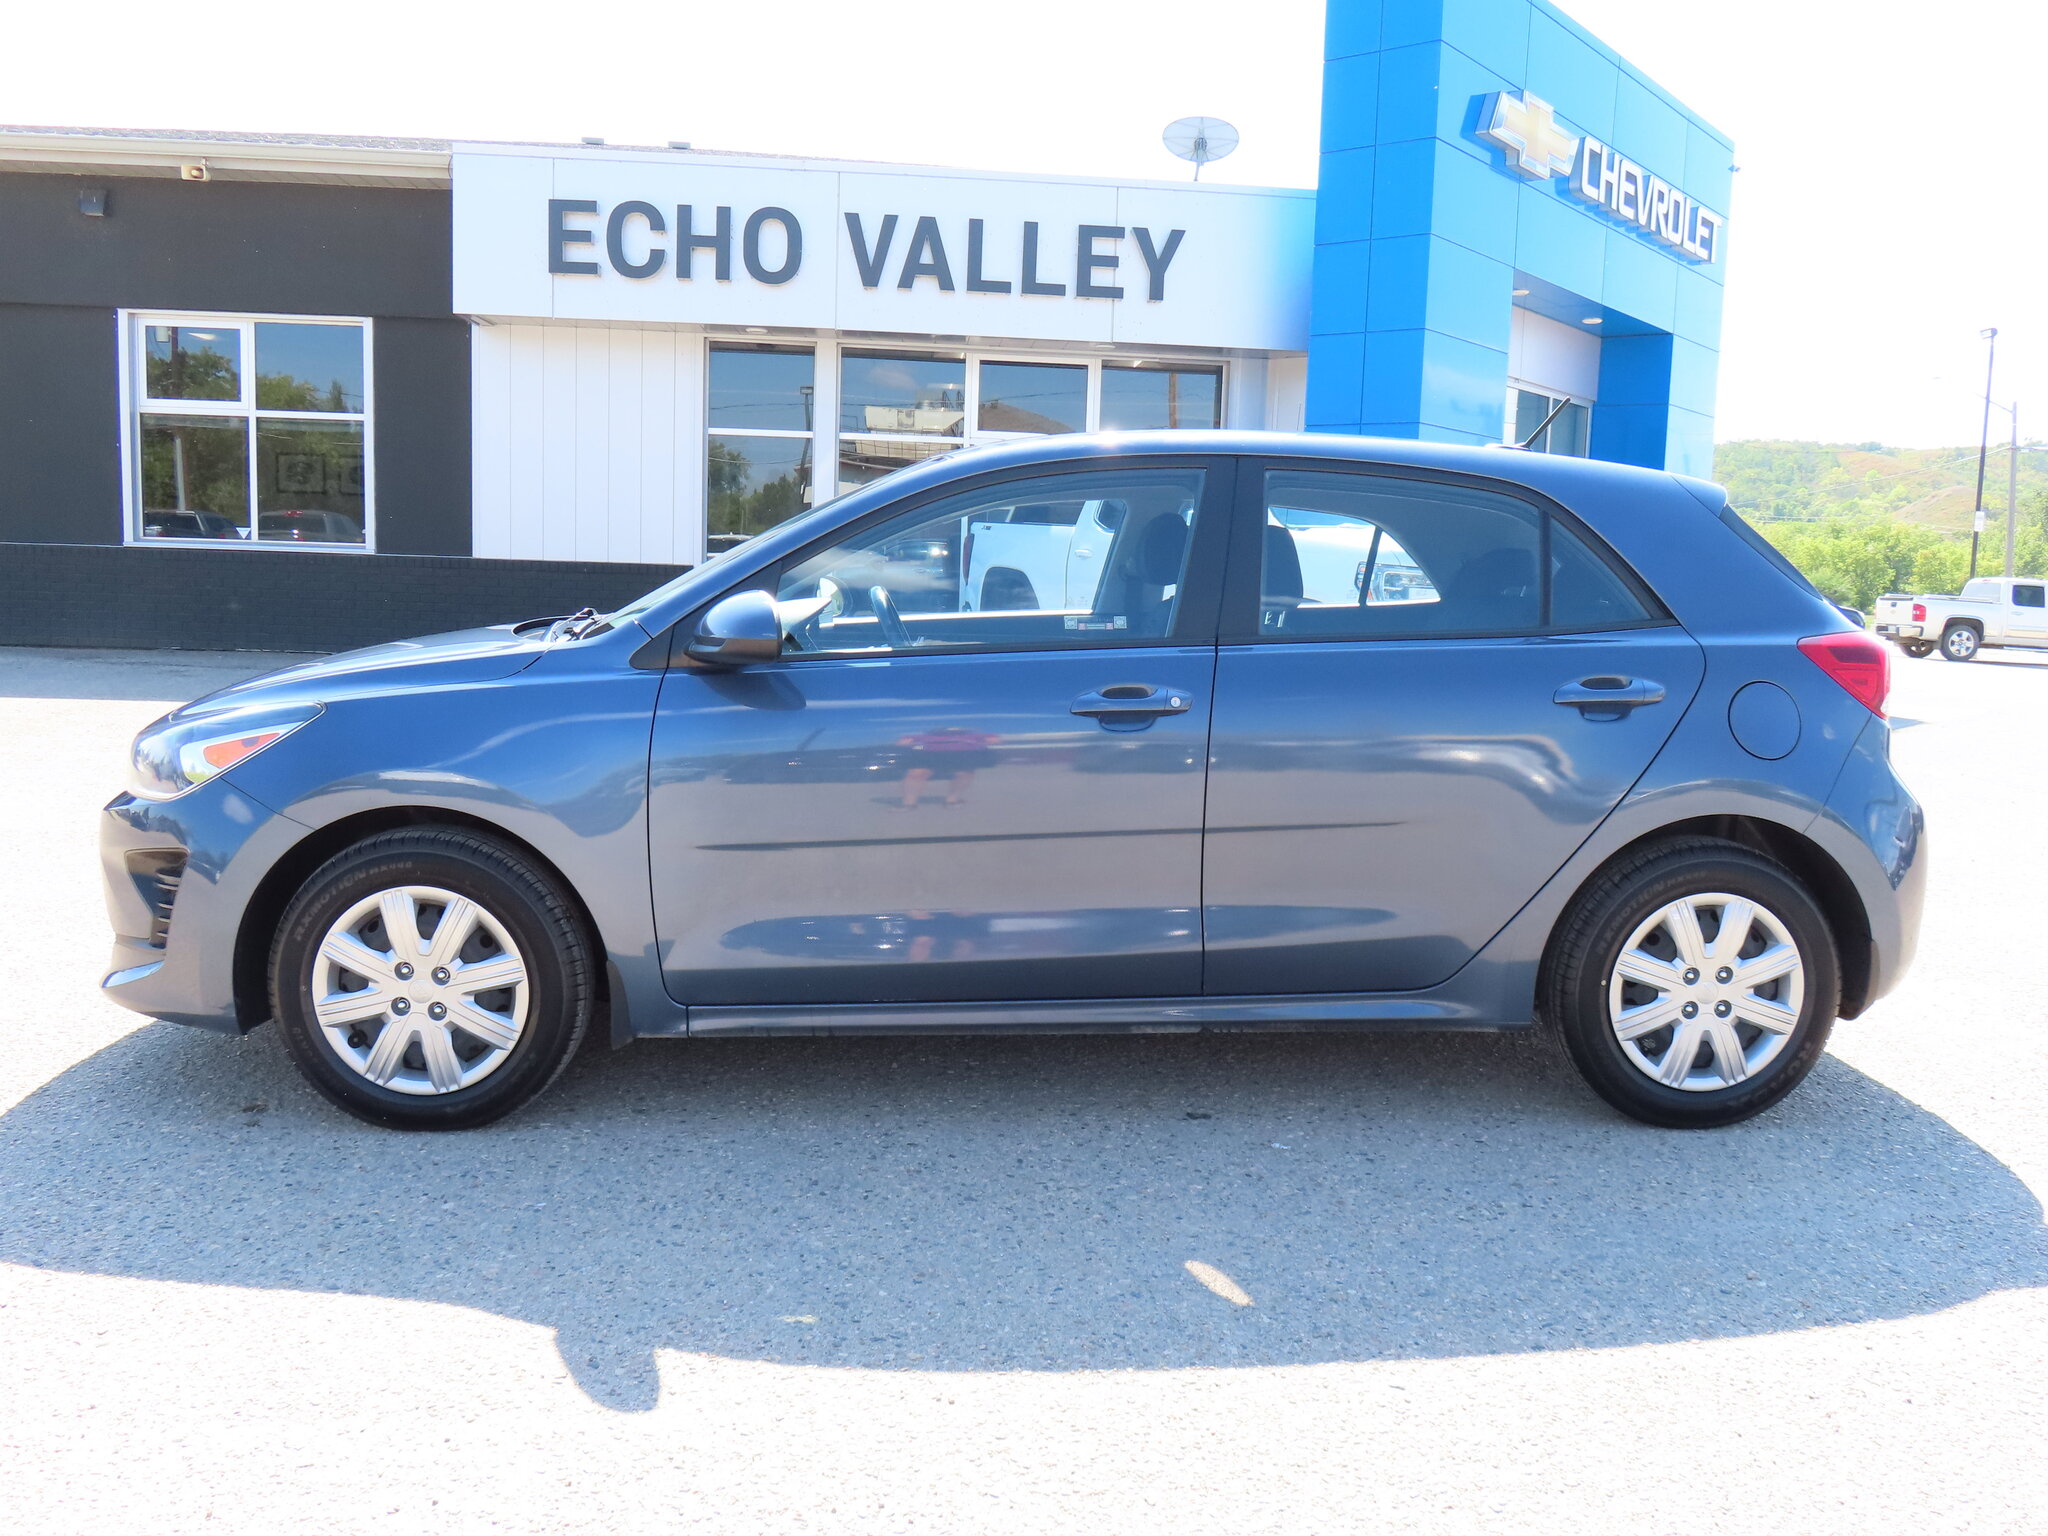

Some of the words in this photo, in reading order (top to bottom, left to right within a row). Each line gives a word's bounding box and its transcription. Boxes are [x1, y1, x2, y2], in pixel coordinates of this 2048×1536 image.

[548, 198, 802, 286] ECHO
[844, 211, 1187, 303] VALLEY
[1581, 136, 1723, 264] CHEVROLET
